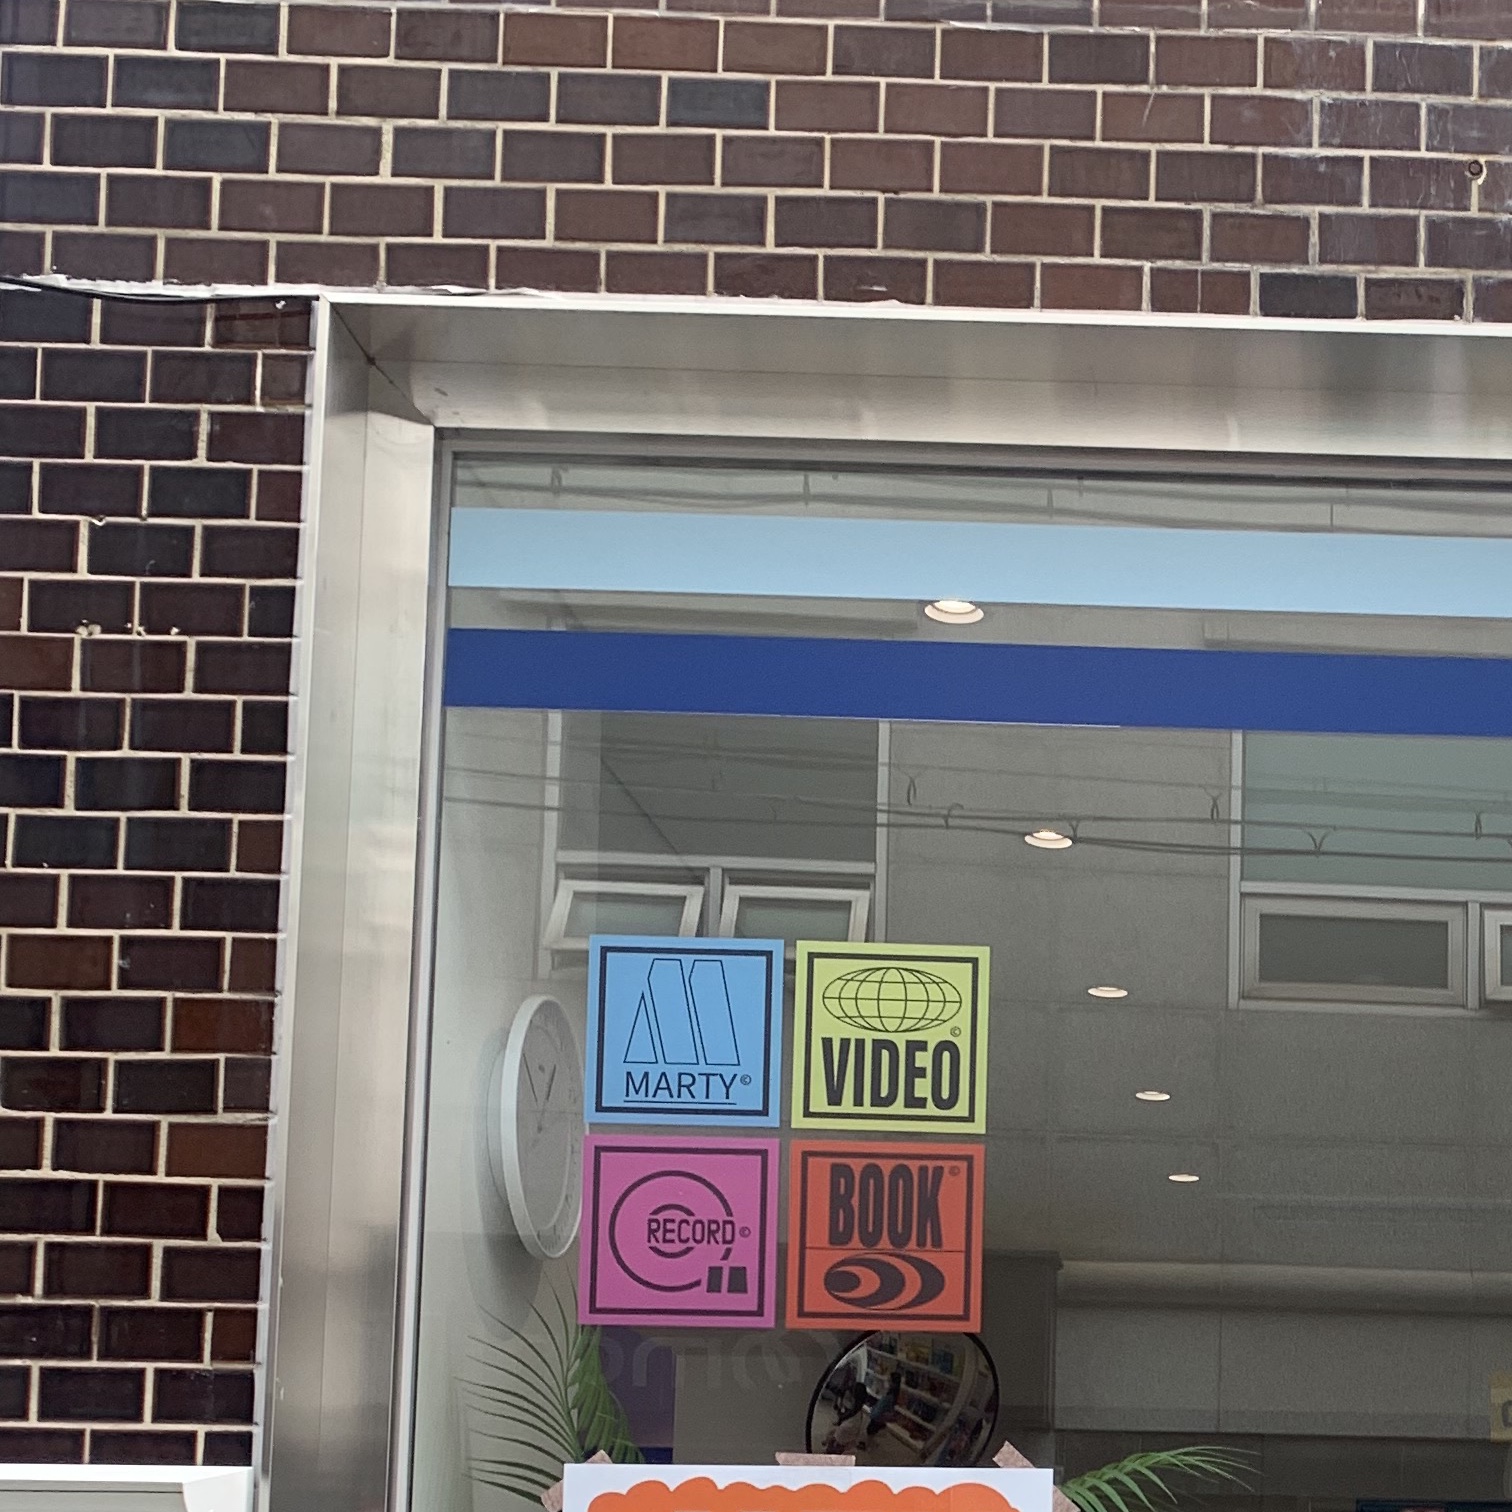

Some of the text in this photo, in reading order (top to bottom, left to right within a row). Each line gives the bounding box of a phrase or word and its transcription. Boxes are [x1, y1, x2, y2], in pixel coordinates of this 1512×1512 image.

[820, 1036, 962, 1112] VIDEO
[646, 1217, 735, 1246] RECORD
[828, 1162, 945, 1250] BOOK
